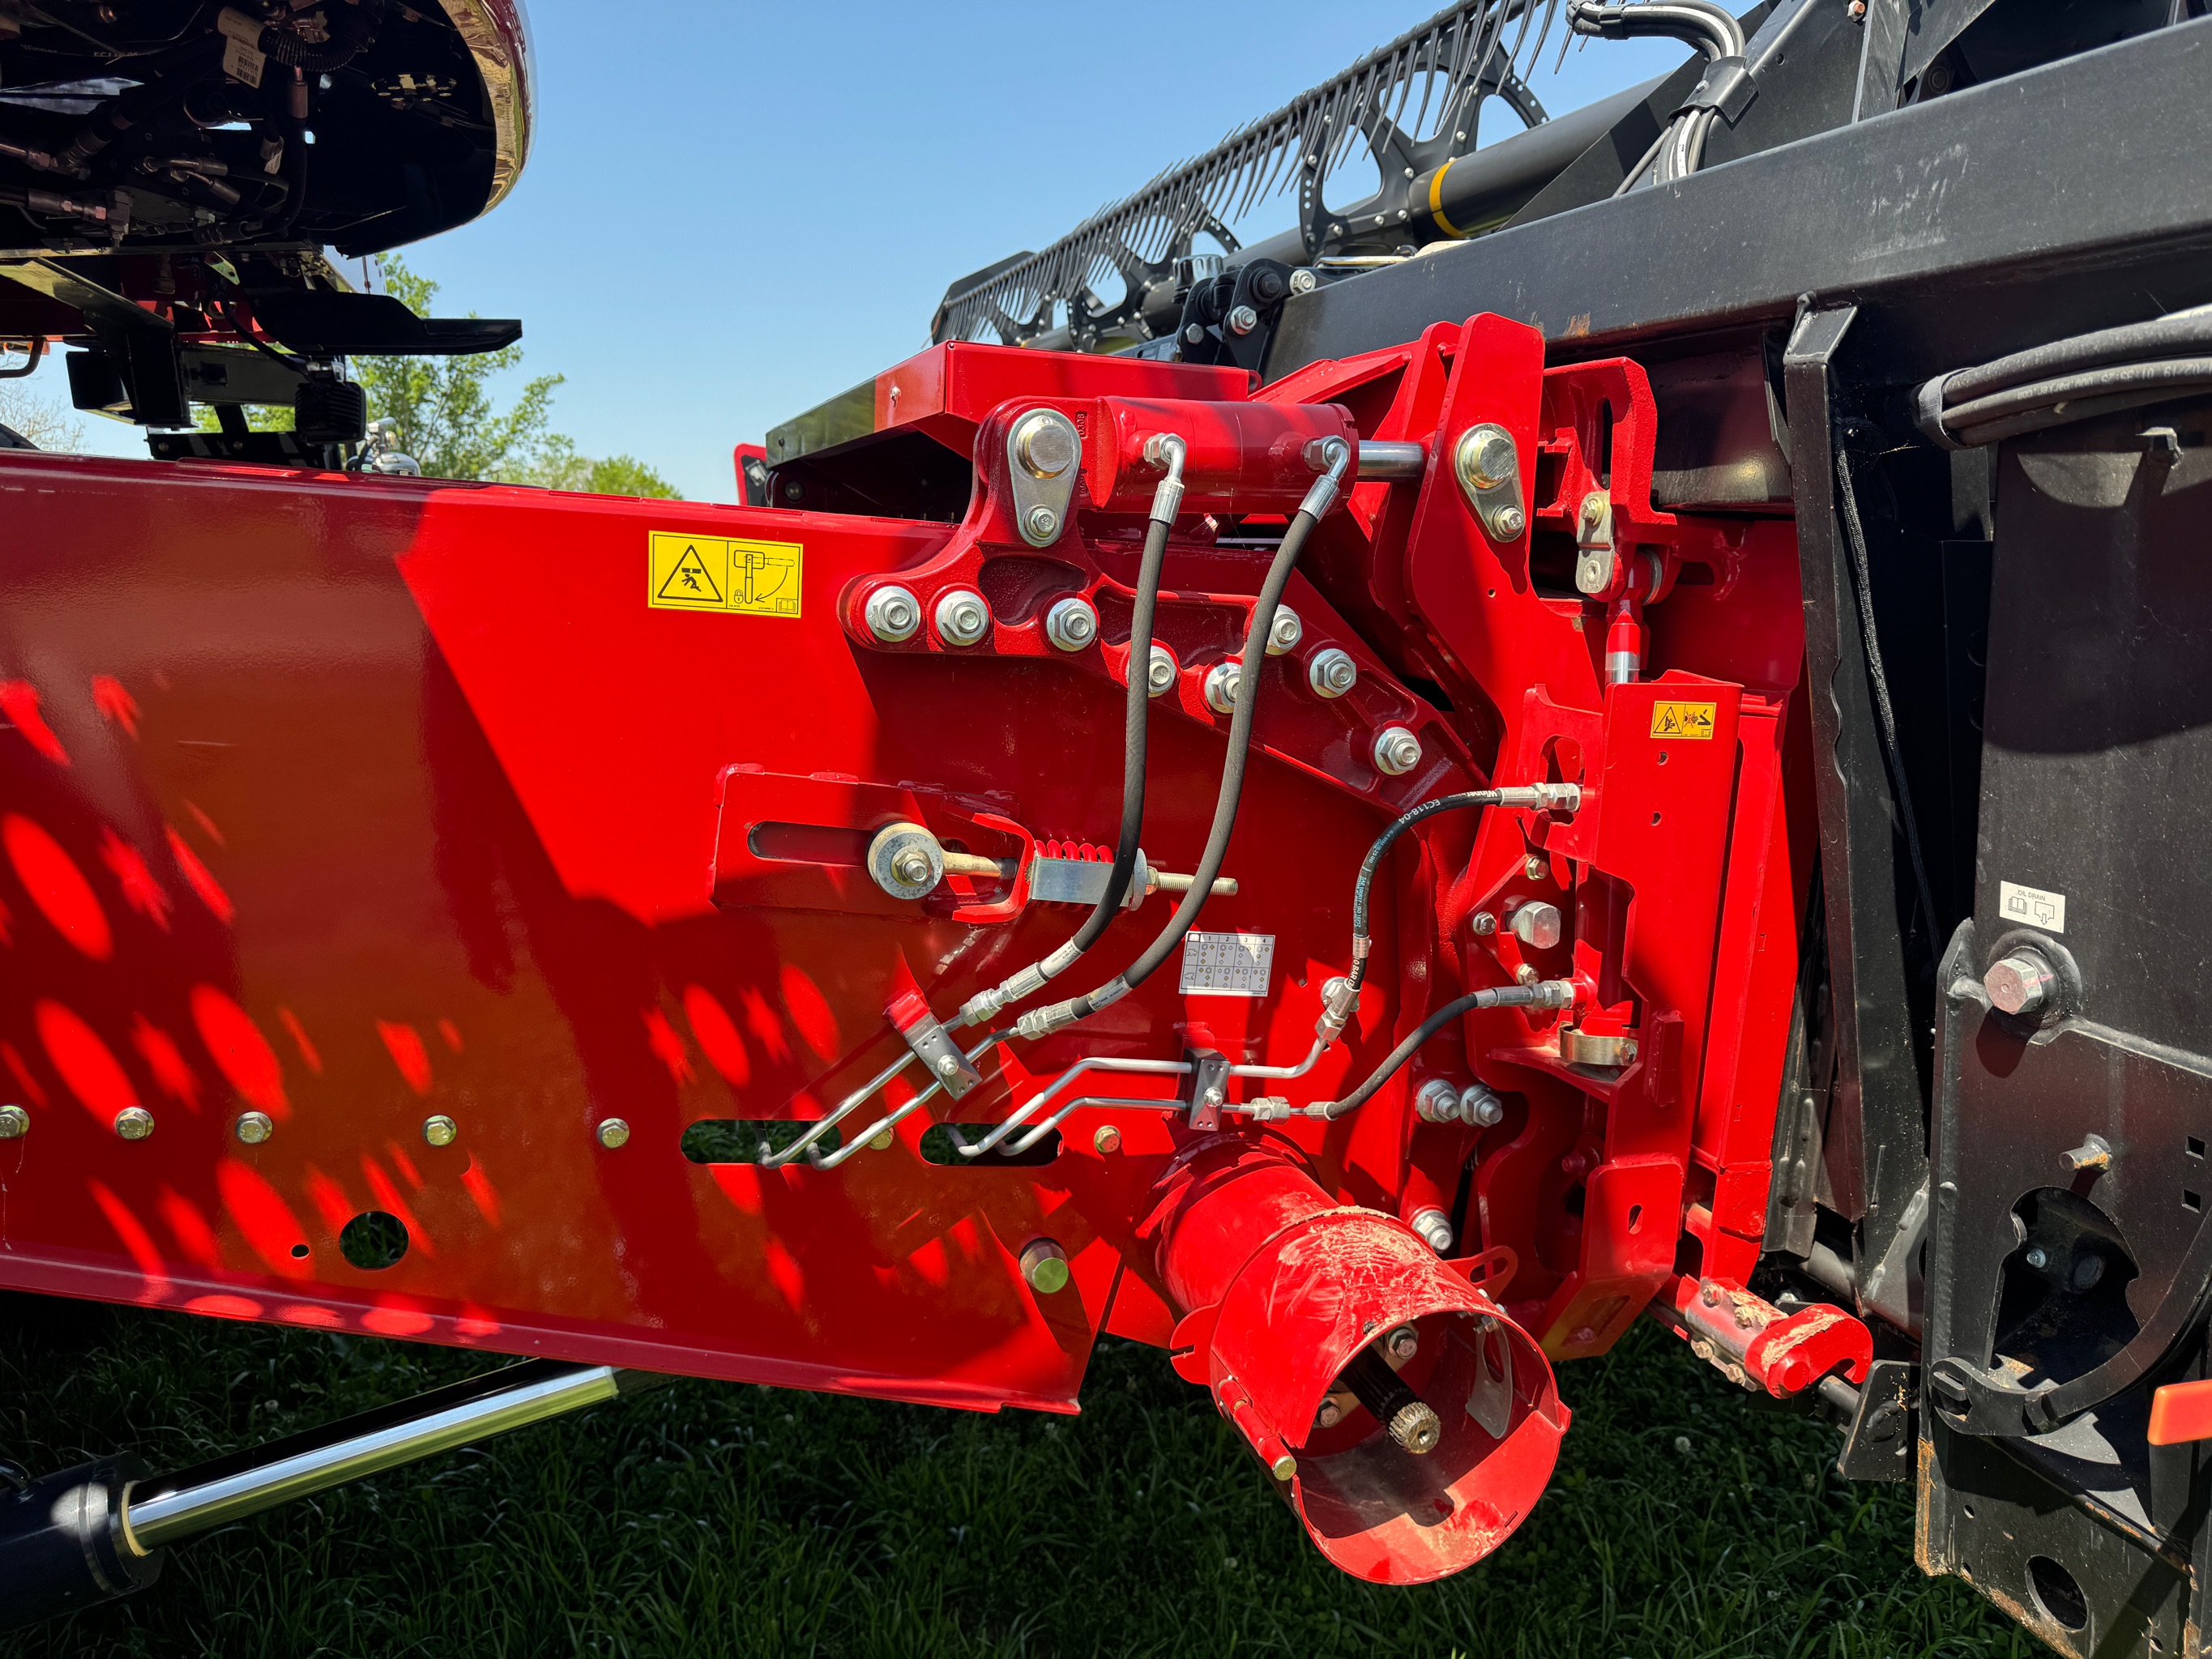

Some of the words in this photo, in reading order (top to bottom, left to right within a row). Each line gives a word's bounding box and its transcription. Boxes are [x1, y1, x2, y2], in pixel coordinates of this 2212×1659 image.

[1466, 790, 1498, 798] Winner
[1398, 799, 1441, 825] EC118-04
[2028, 892, 2046, 901] DRAIN
[1350, 965, 1360, 979] BAR
